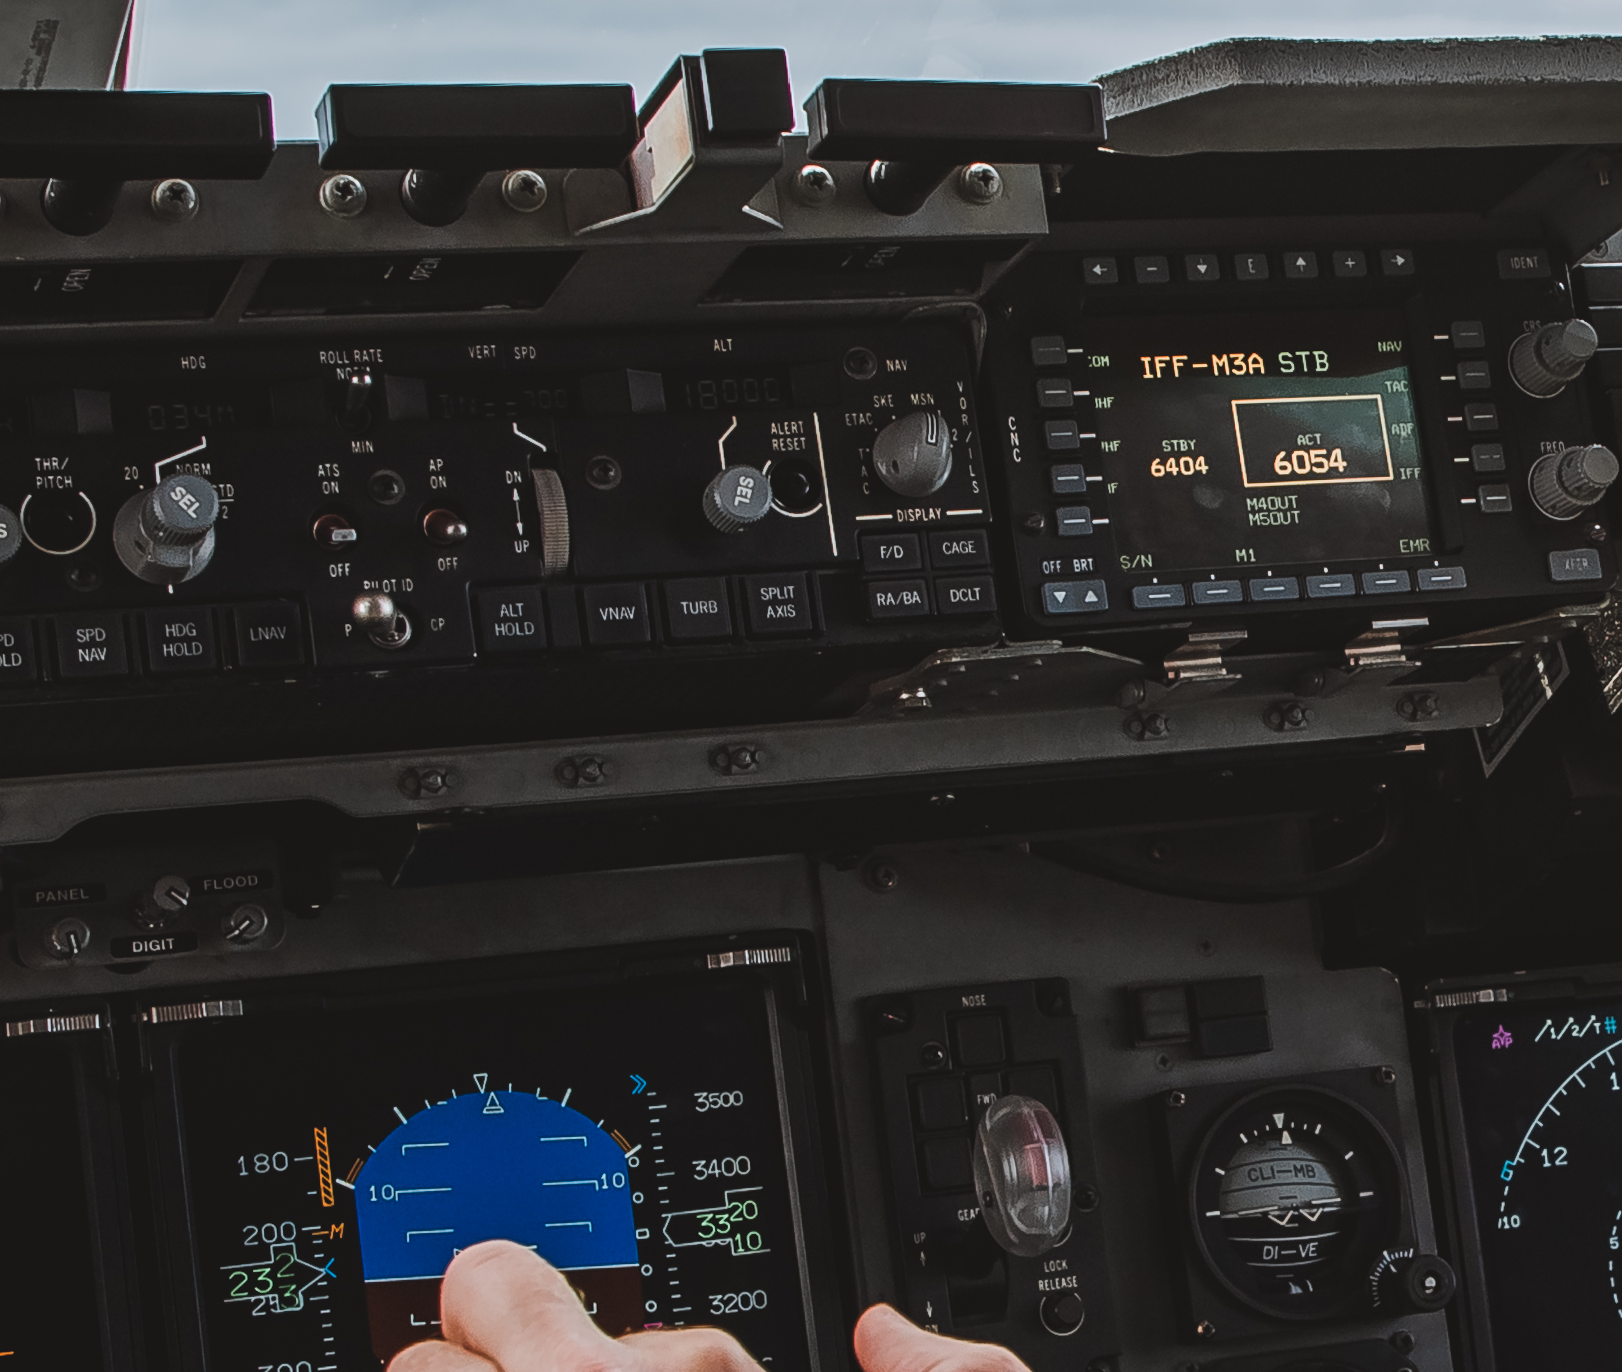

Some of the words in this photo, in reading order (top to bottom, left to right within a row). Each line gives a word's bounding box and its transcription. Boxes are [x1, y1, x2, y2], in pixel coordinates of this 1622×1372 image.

[1511, 254, 1539, 271] IDENT
[1140, 354, 1265, 378] IFF-M3A
[1279, 351, 1329, 373] STB
[771, 421, 804, 435] ALERT
[1163, 440, 1197, 452] STBY
[1151, 456, 1209, 477] 6404
[1274, 448, 1347, 475] 6054
[35, 473, 73, 489] PITCH
[734, 476, 754, 506] SEL
[171, 485, 202, 518] SEL
[897, 508, 942, 521] DISPLAY
[942, 540, 976, 554] CAGE
[760, 586, 795, 600] SPLIT
[950, 587, 981, 602] DCLT
[680, 600, 718, 614] TURB
[767, 604, 796, 618] AXIS
[203, 874, 259, 891] FLOOD
[35, 888, 90, 903] PANEL
[132, 938, 174, 953] DIGIT
[962, 994, 987, 1007] NOSE
[694, 1090, 744, 1111] 3500
[238, 1152, 289, 1176] 180
[1541, 1147, 1568, 1167] 12
[692, 1156, 752, 1179] 3400
[601, 1172, 625, 1189] 10
[369, 1185, 395, 1201] 10
[242, 1221, 296, 1245] 200
[1044, 1259, 1068, 1272] LOCK
[1038, 1275, 1078, 1292] RELEASE
[708, 1289, 768, 1313] 3200
